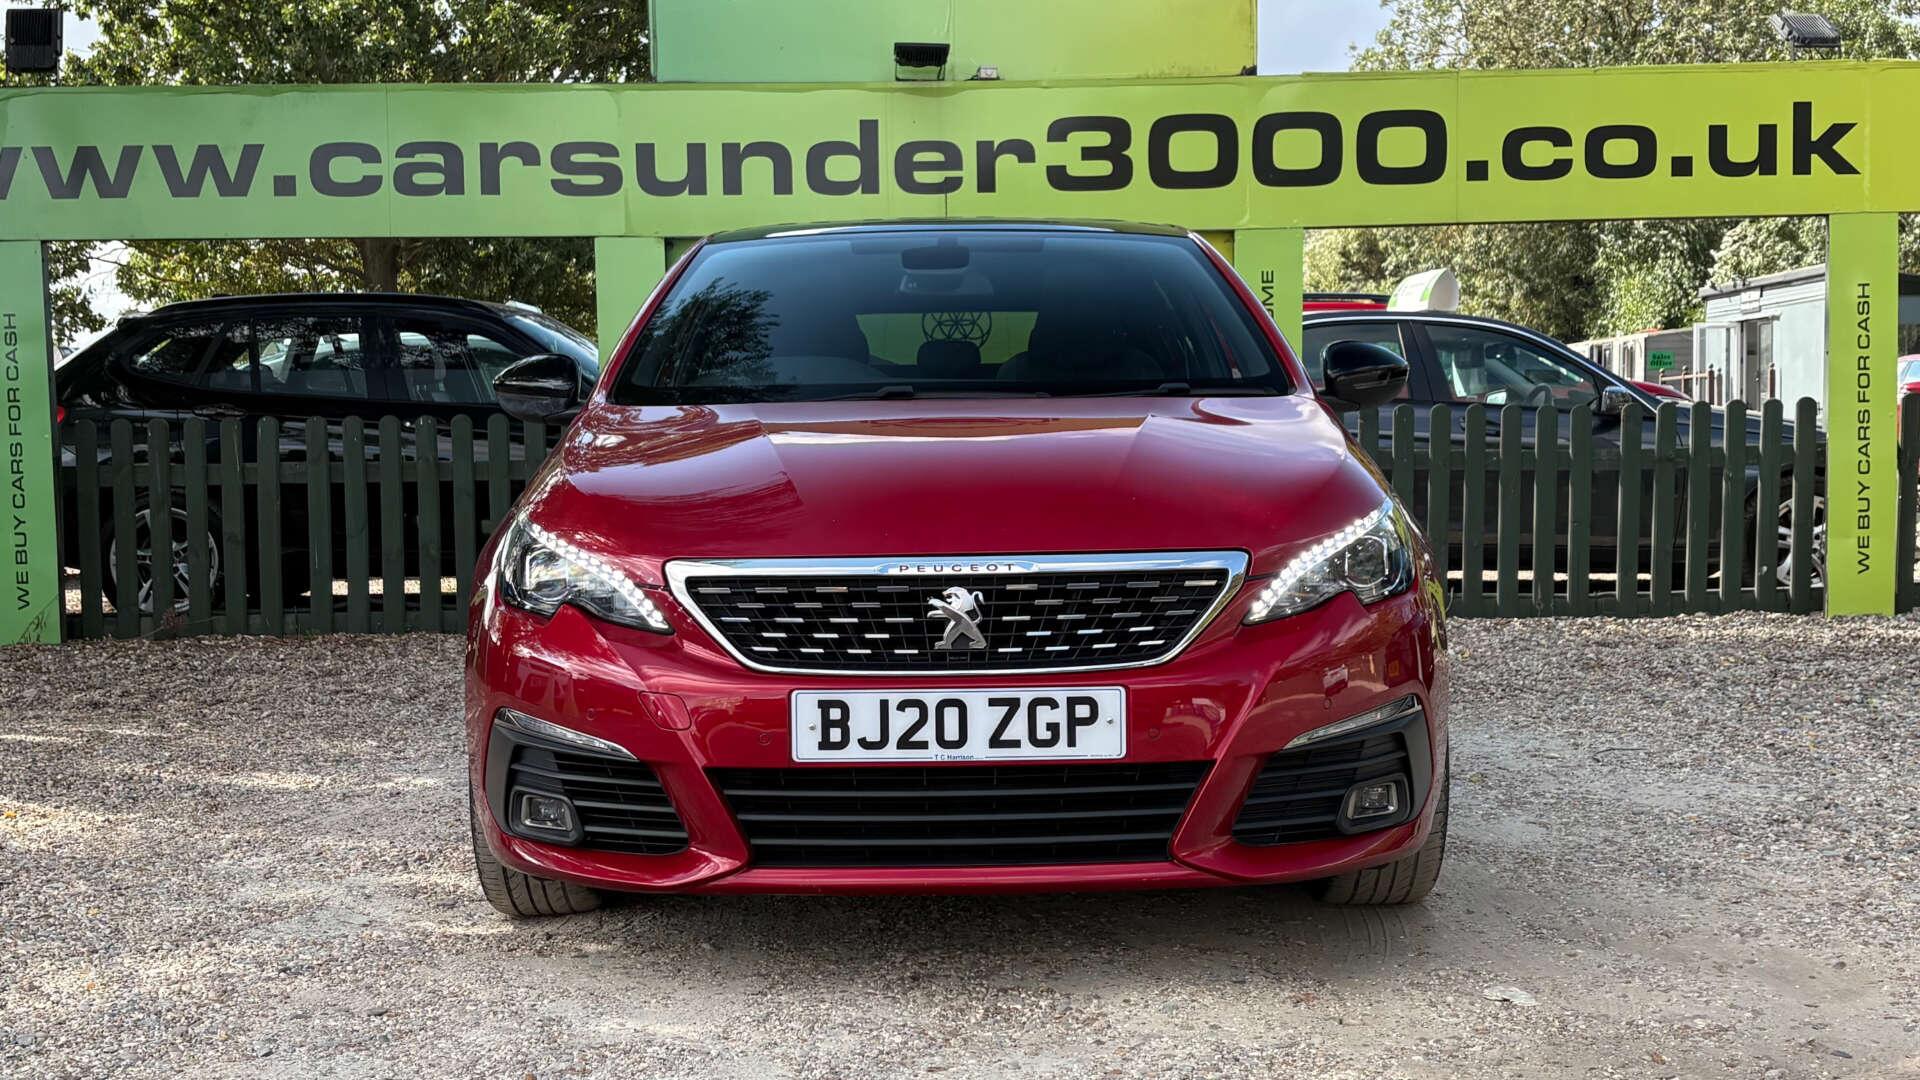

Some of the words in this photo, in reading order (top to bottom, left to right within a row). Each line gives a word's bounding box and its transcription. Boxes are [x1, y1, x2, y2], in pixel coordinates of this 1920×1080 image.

[0, 101, 1861, 200] ww.carsunder3000.co.uk
[1857, 283, 1870, 349] CASH
[3, 313, 19, 381] CASH
[1857, 356, 1870, 403] FOR
[7, 387, 22, 436] FOR
[1857, 409, 1870, 475] CARS
[10, 442, 25, 509] CARS
[1857, 481, 1870, 530] BUY
[13, 515, 28, 565] BUY
[1857, 535, 1870, 575] WE
[16, 571, 30, 610] WE
[899, 563, 1015, 573] PEUGEOT
[817, 698, 968, 751] BJ20
[988, 696, 1099, 749] ZGP
